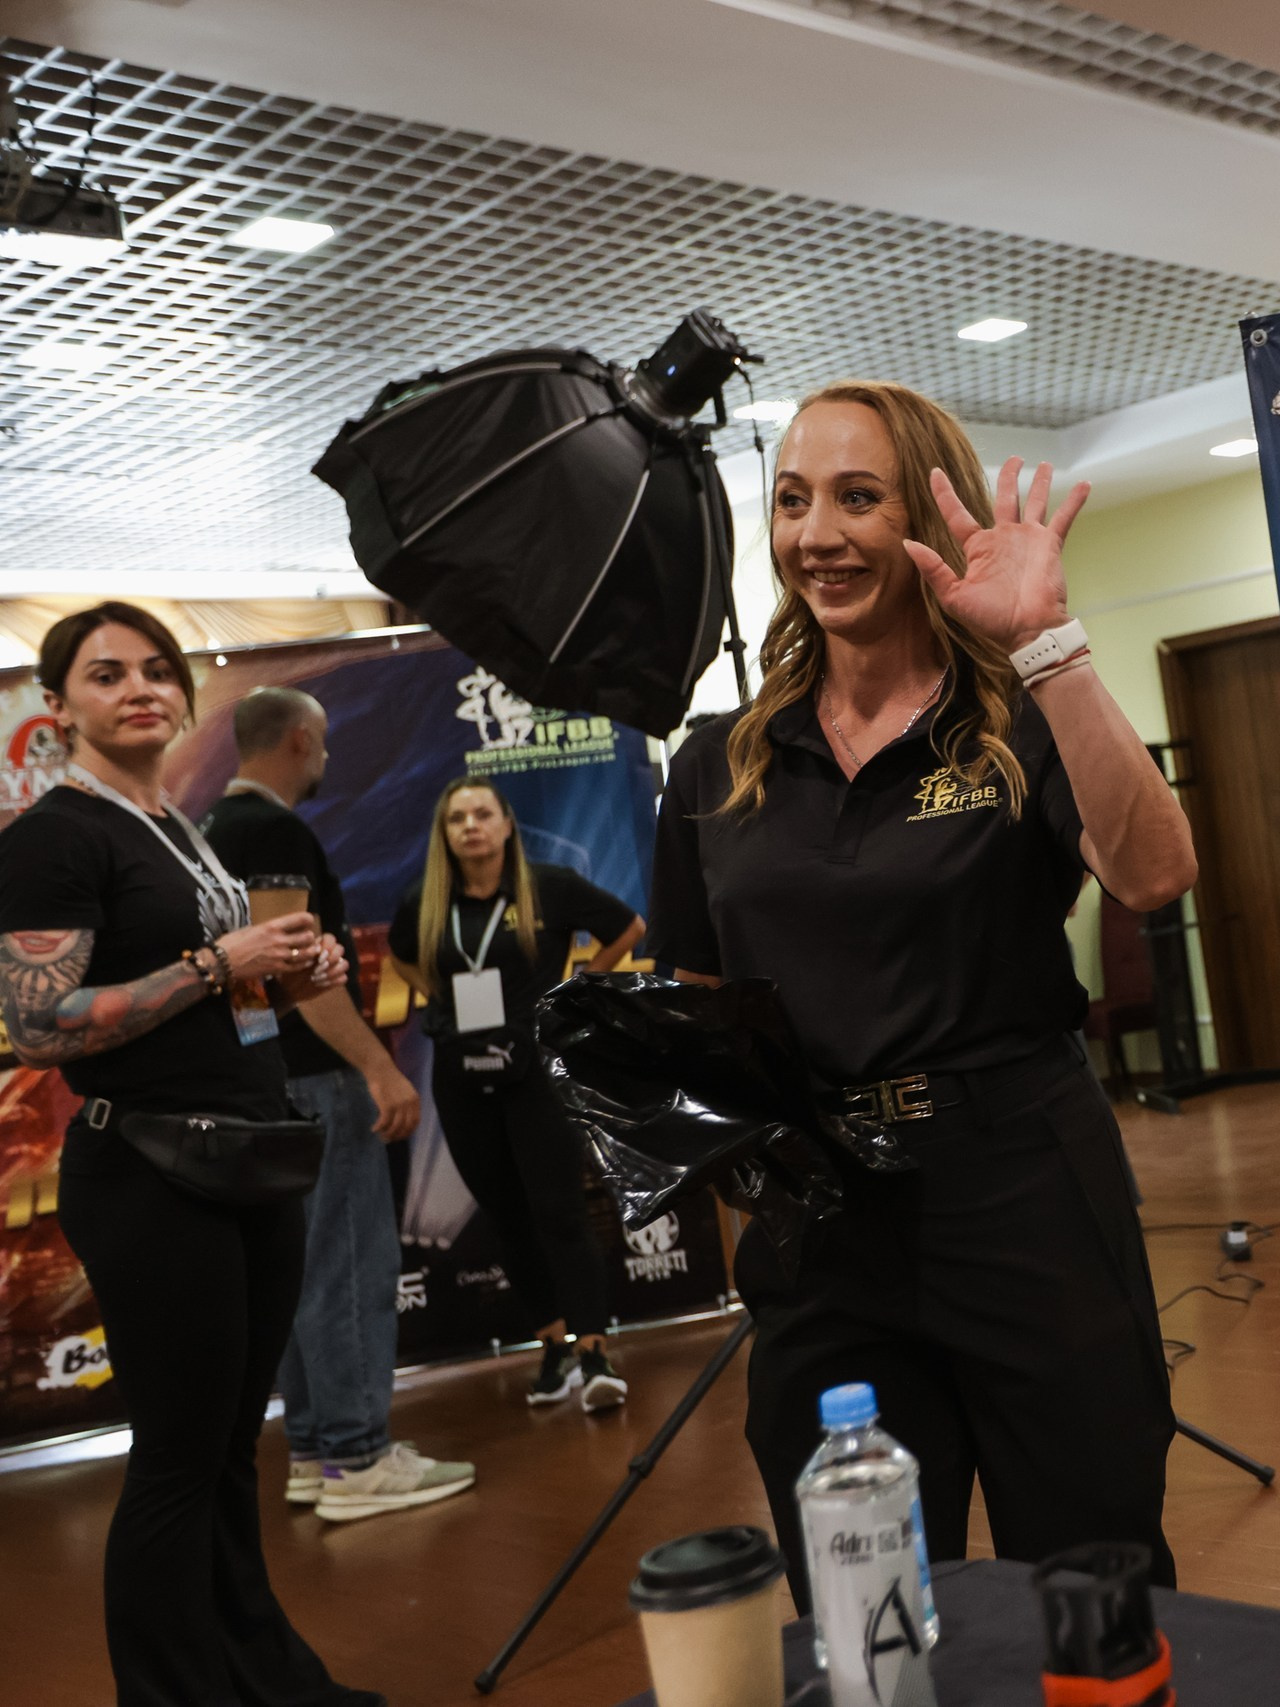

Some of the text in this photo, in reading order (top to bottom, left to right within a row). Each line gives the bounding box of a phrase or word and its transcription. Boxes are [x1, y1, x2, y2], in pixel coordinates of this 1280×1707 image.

[534, 715, 614, 746] IFBB
[464, 736, 615, 765] PROFESSIONAL LEAGUE
[952, 786, 998, 808] IFBB
[906, 799, 999, 823] PROFESSIONAL LEAGUE
